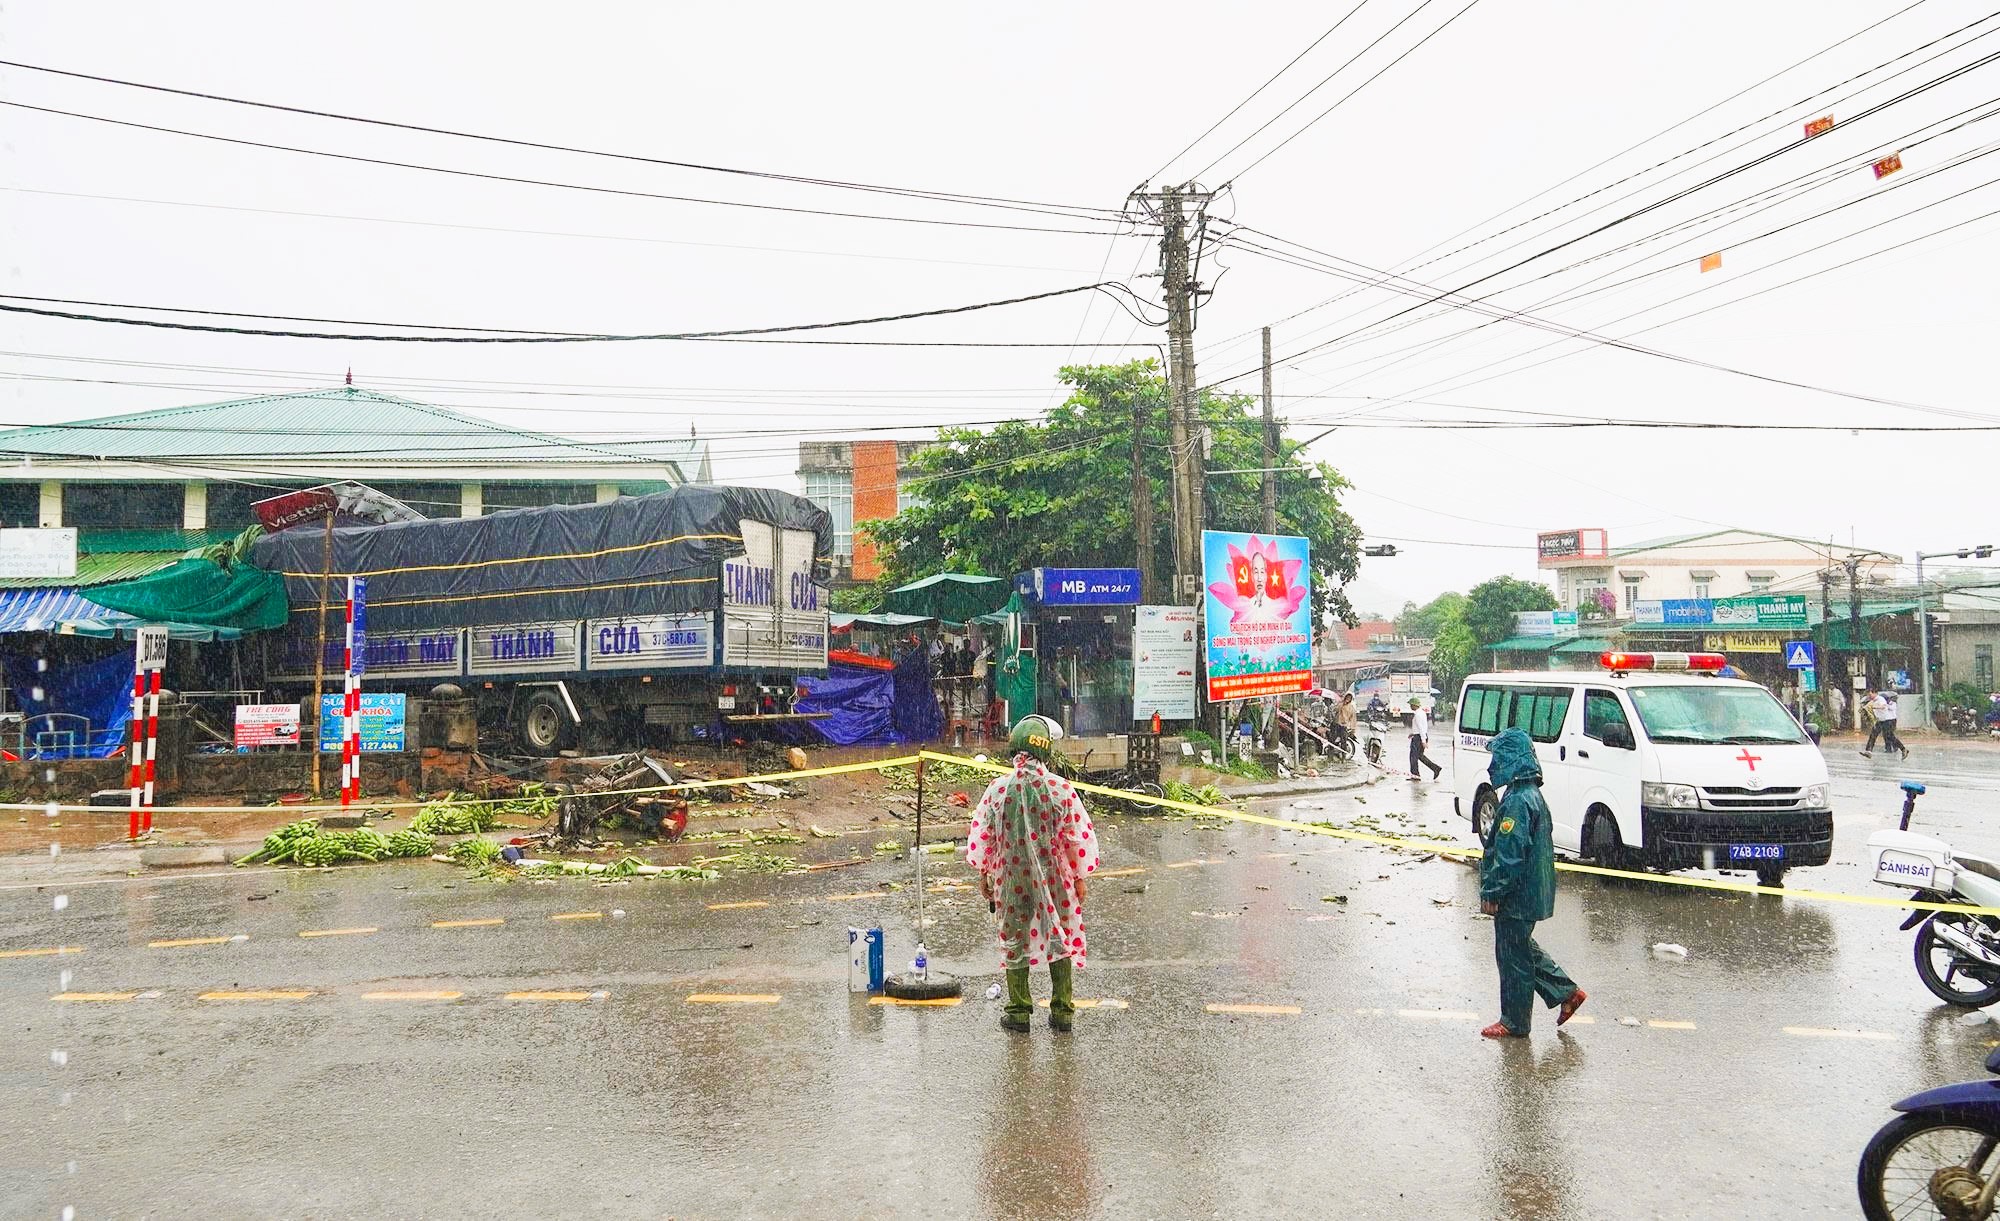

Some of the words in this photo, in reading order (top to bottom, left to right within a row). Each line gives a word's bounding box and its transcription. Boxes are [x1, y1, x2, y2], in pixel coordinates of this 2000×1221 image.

[267, 501, 333, 528] Viettel
[1061, 580, 1086, 594] MB
[1090, 585, 1109, 593] ATM
[1111, 584, 1131, 593] 24/7
[1758, 603, 1789, 614] THANH
[652, 632, 697, 646] 37C-587.63
[1732, 846, 1752, 858] 74B
[1754, 846, 1780, 858] 2109
[1879, 859, 1910, 876] CẢNH
[1911, 863, 1931, 877] SÁT
